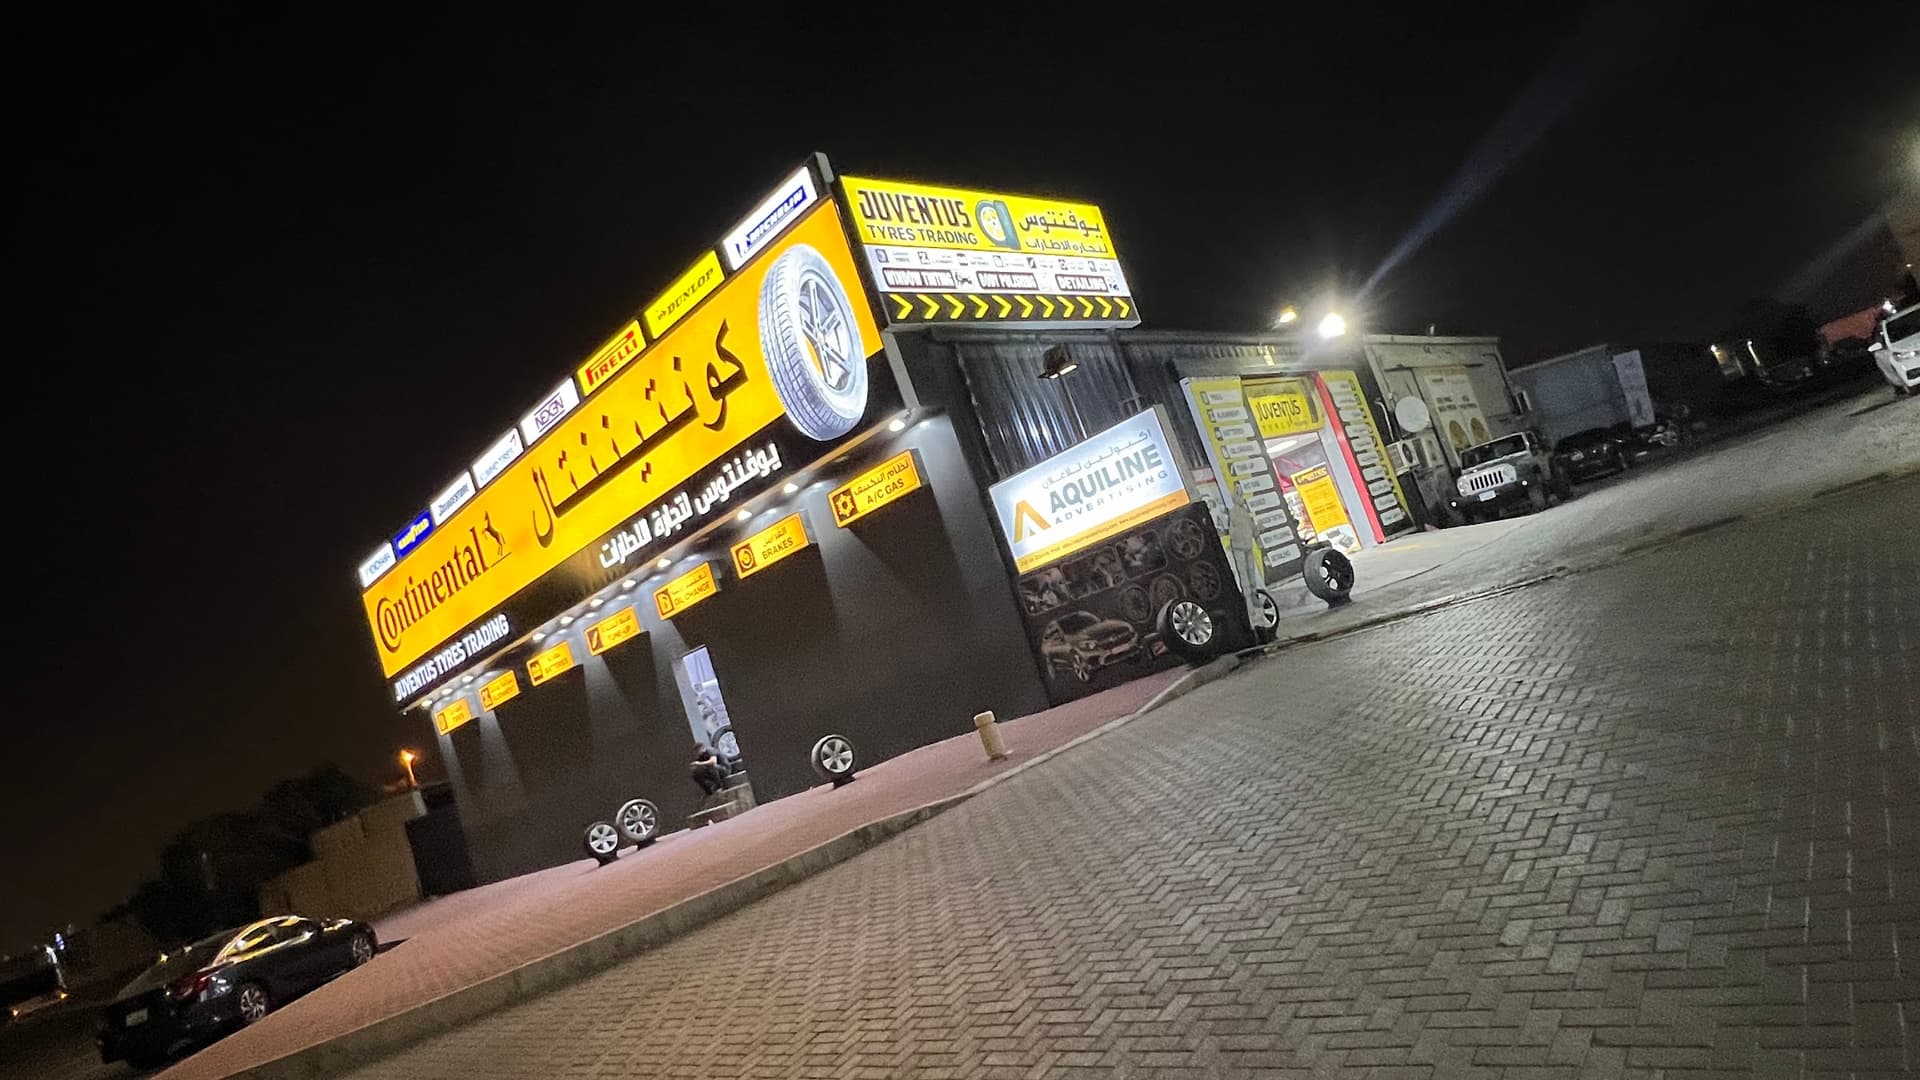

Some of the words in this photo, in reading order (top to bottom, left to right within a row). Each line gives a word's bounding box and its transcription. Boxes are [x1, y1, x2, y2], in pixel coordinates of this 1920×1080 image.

[857, 190, 972, 228] JUVENTUS
[1019, 210, 1103, 239] يوفنتوس
[866, 225, 916, 241] TYRES
[917, 228, 978, 245] TRADING
[666, 267, 715, 315] DUNLOP
[585, 331, 639, 387] PIRELLI
[532, 318, 749, 548] كونتيننتال
[1256, 397, 1301, 425] JUVENTUS
[695, 442, 783, 515] يوفنتوس
[866, 490, 885, 506] A/C
[884, 478, 905, 498] GAS
[1050, 443, 1163, 513] AQUILINE
[1055, 469, 1169, 525] ADVERTISING
[761, 537, 794, 561] BRAKES
[376, 525, 489, 654] Continental
[684, 581, 711, 602] CHANGE
[394, 660, 438, 702] JUVENTUS
[434, 641, 467, 675] TYRES
[462, 613, 510, 657] TRADING
